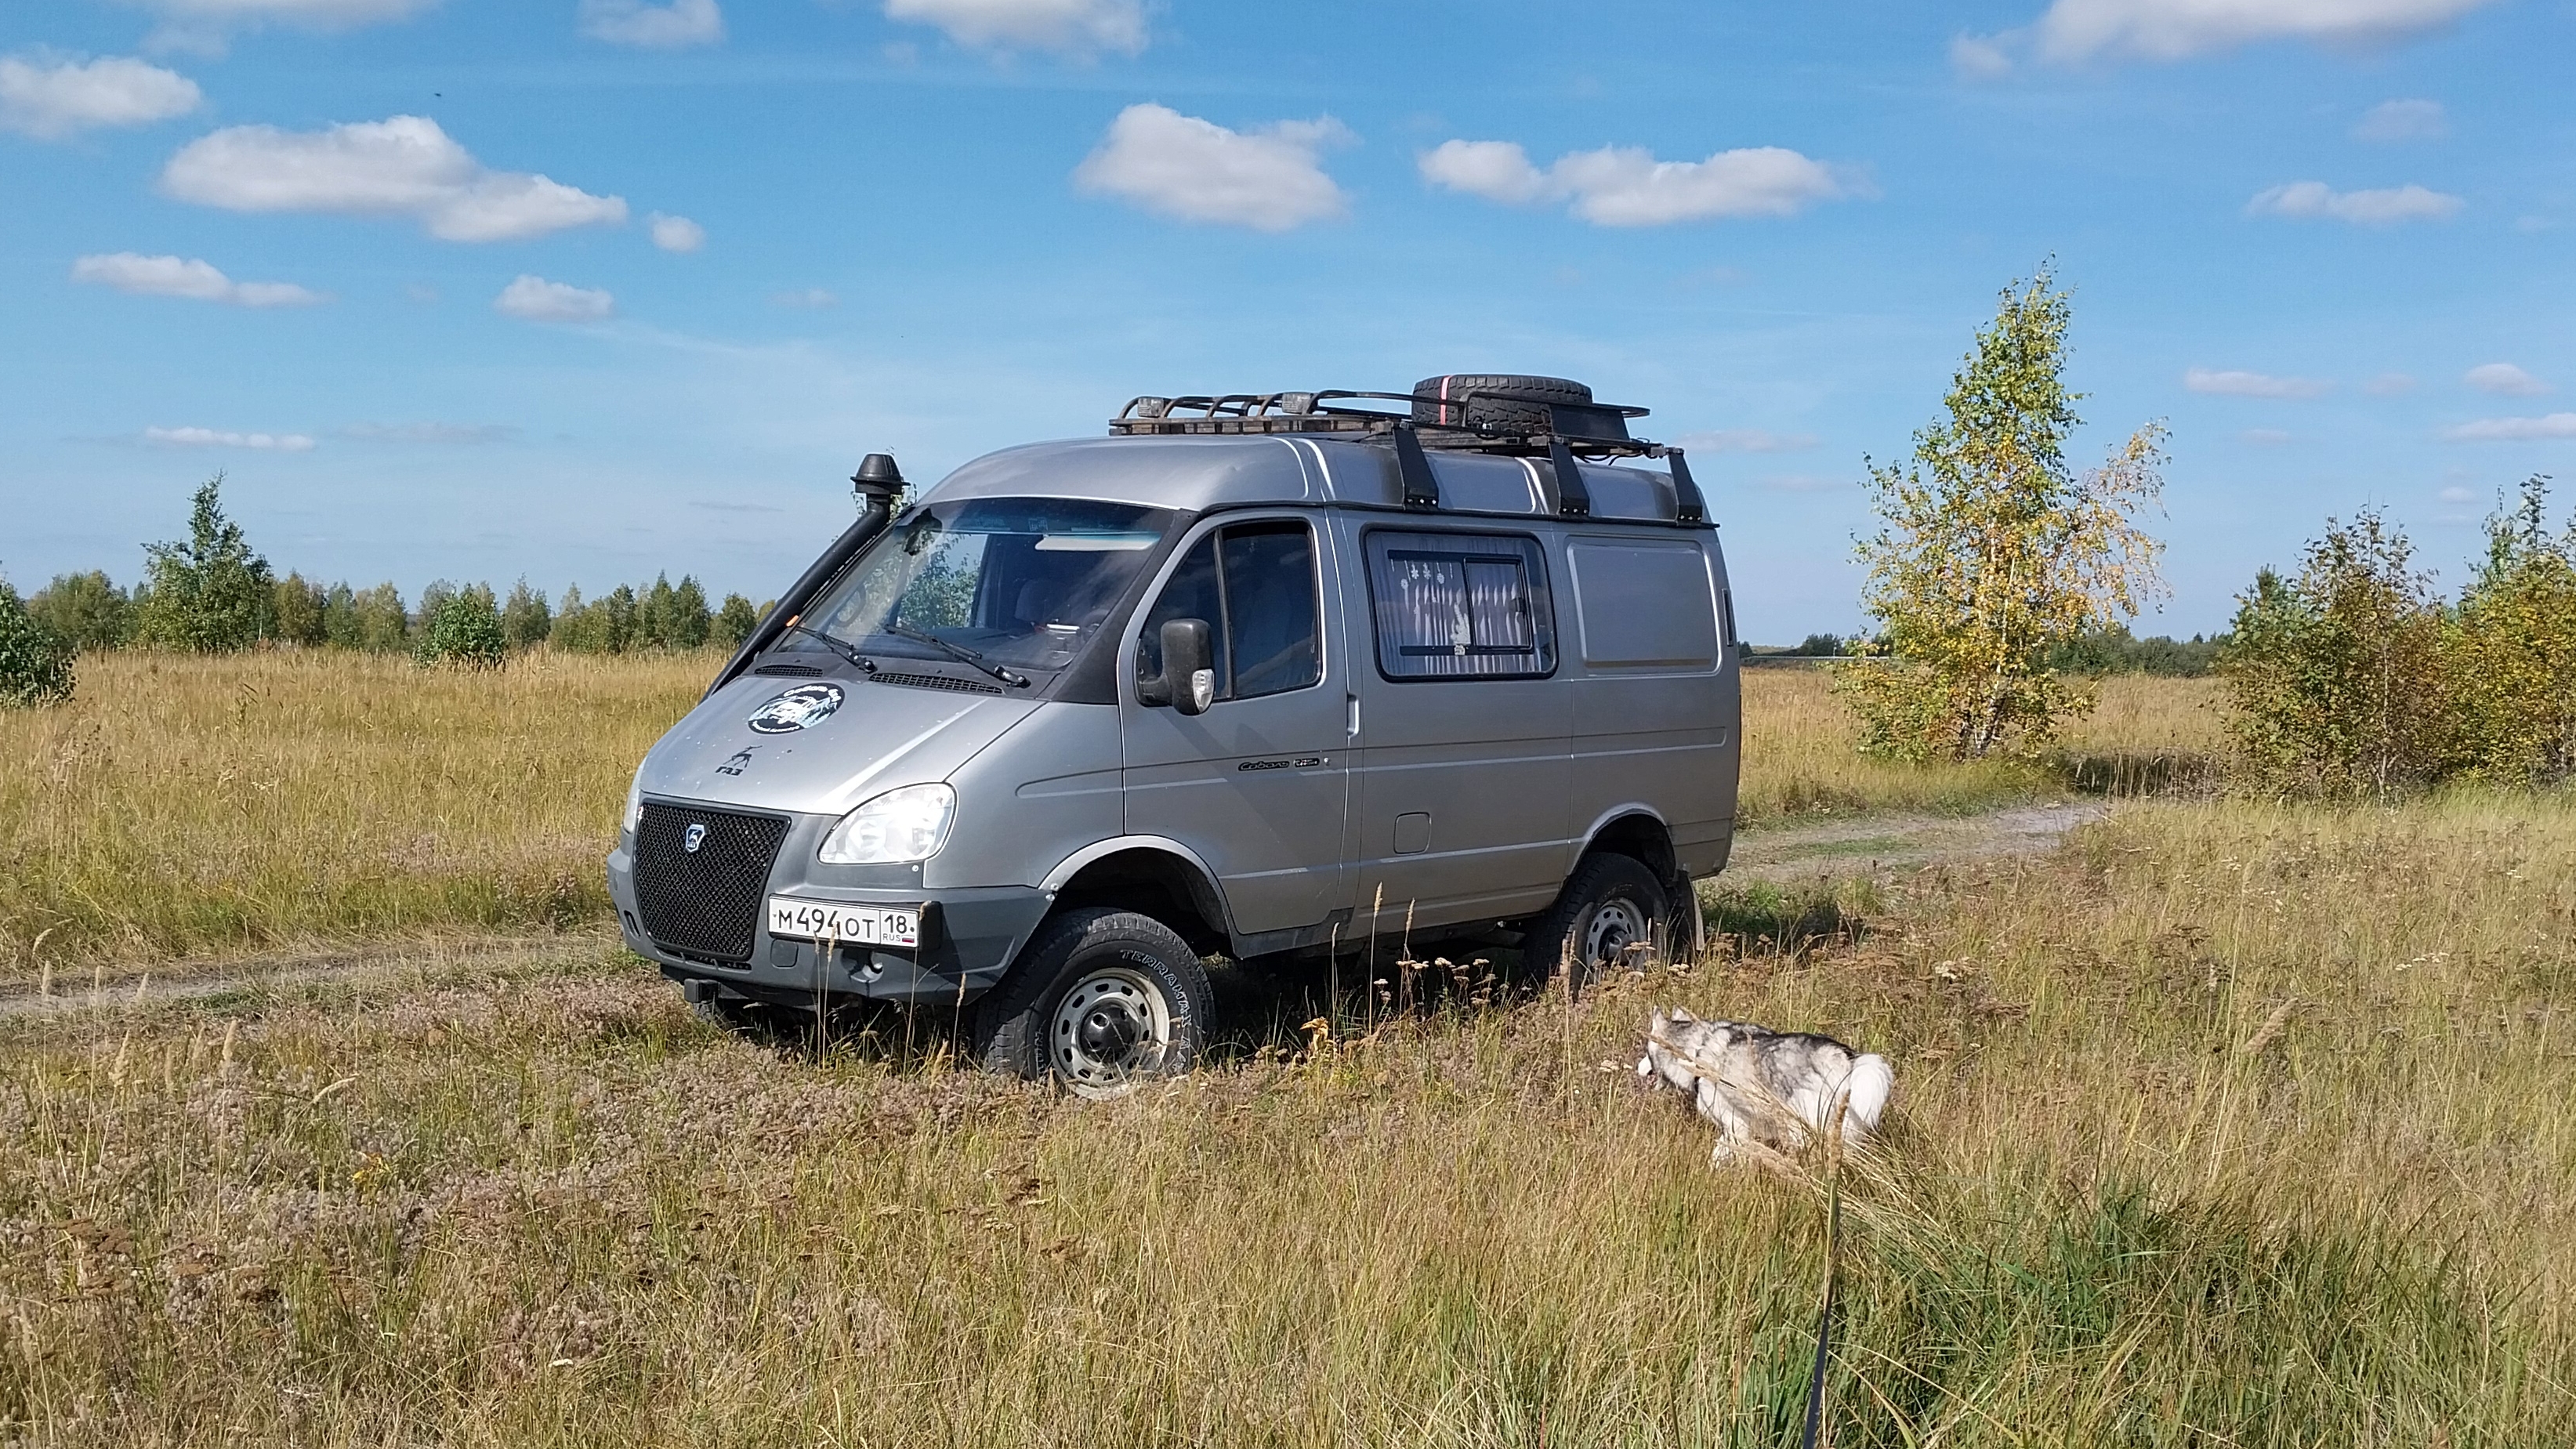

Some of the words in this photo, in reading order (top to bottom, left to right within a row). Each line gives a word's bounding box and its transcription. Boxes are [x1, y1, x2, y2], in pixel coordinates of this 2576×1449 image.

[715, 766, 744, 776] ГАЗ
[778, 907, 875, 939] М494ОТ
[884, 914, 908, 934] 18
[883, 933, 900, 942] RUS
[1120, 948, 1192, 1027] TERRAMAX
